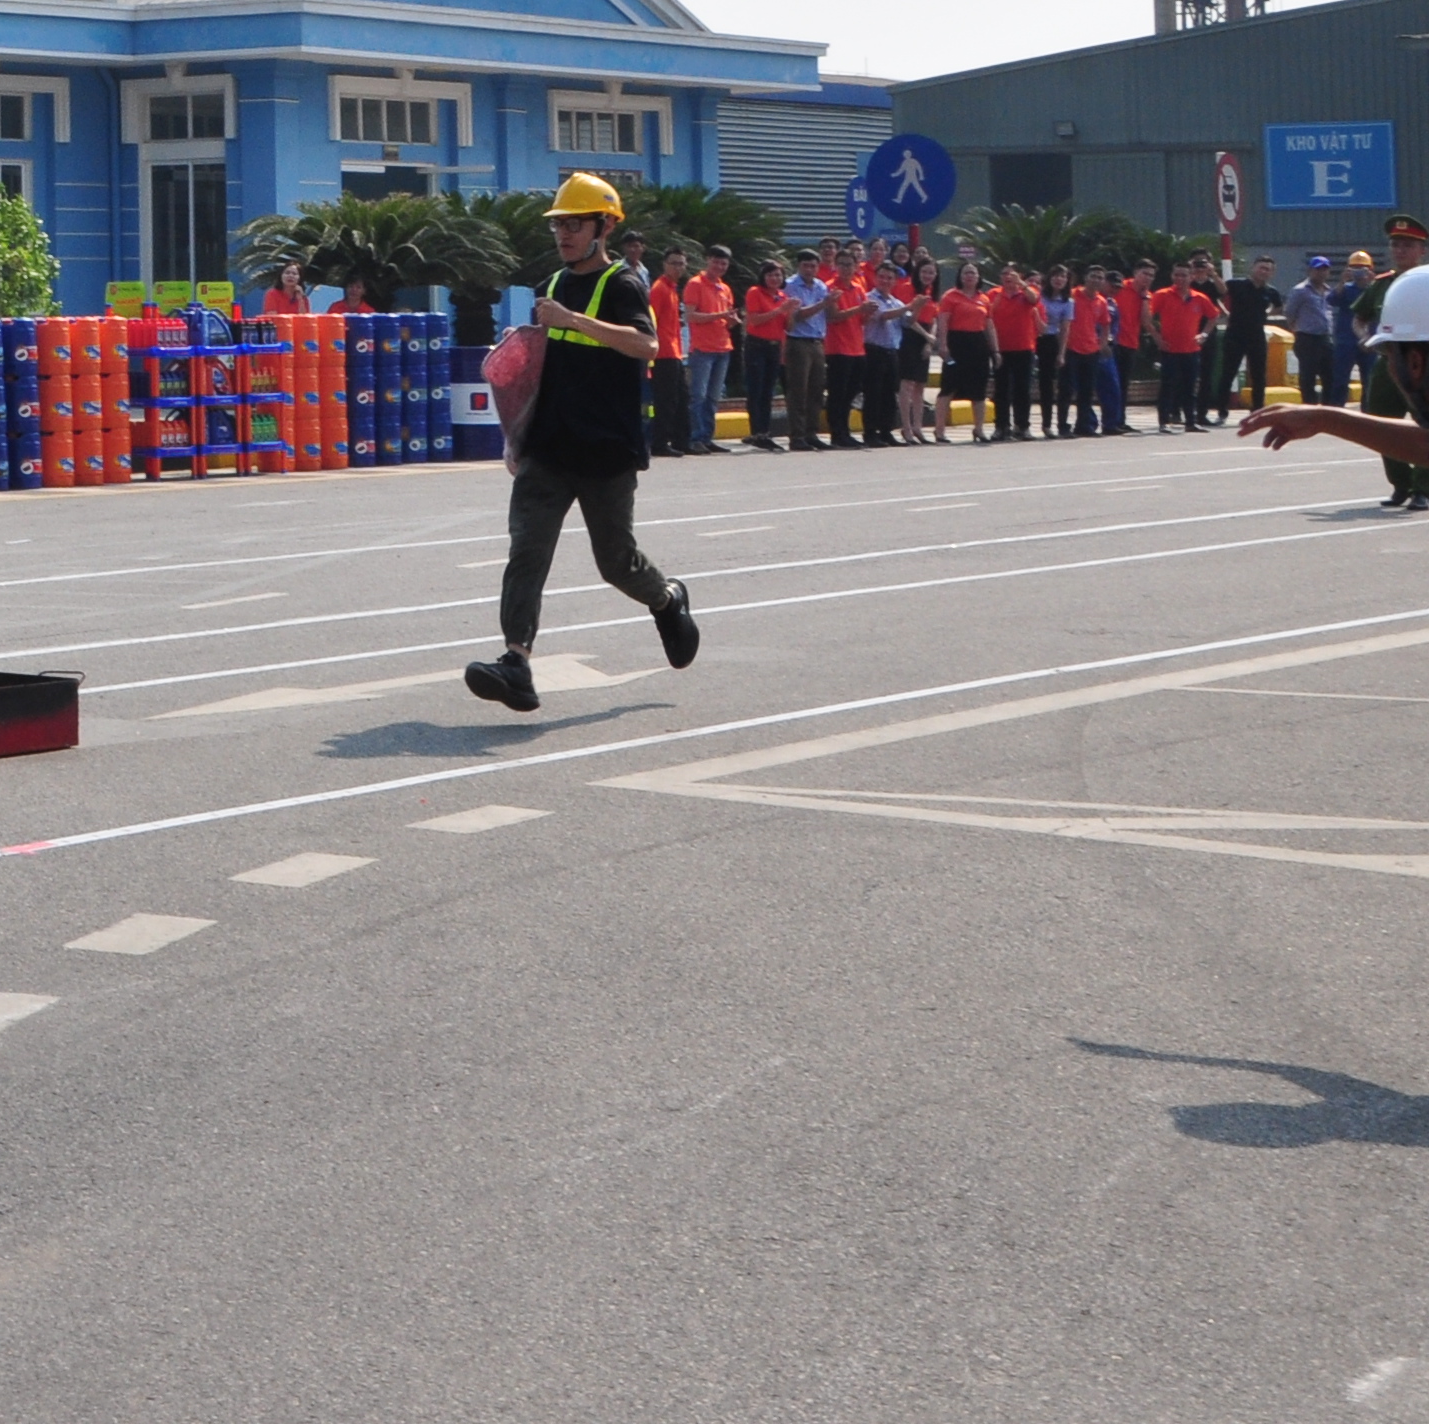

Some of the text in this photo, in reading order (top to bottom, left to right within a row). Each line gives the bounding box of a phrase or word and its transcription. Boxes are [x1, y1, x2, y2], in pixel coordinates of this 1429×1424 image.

[1286, 131, 1373, 154] KHO VẬT TƯ
[1309, 161, 1354, 197] E
[857, 207, 865, 229] C
